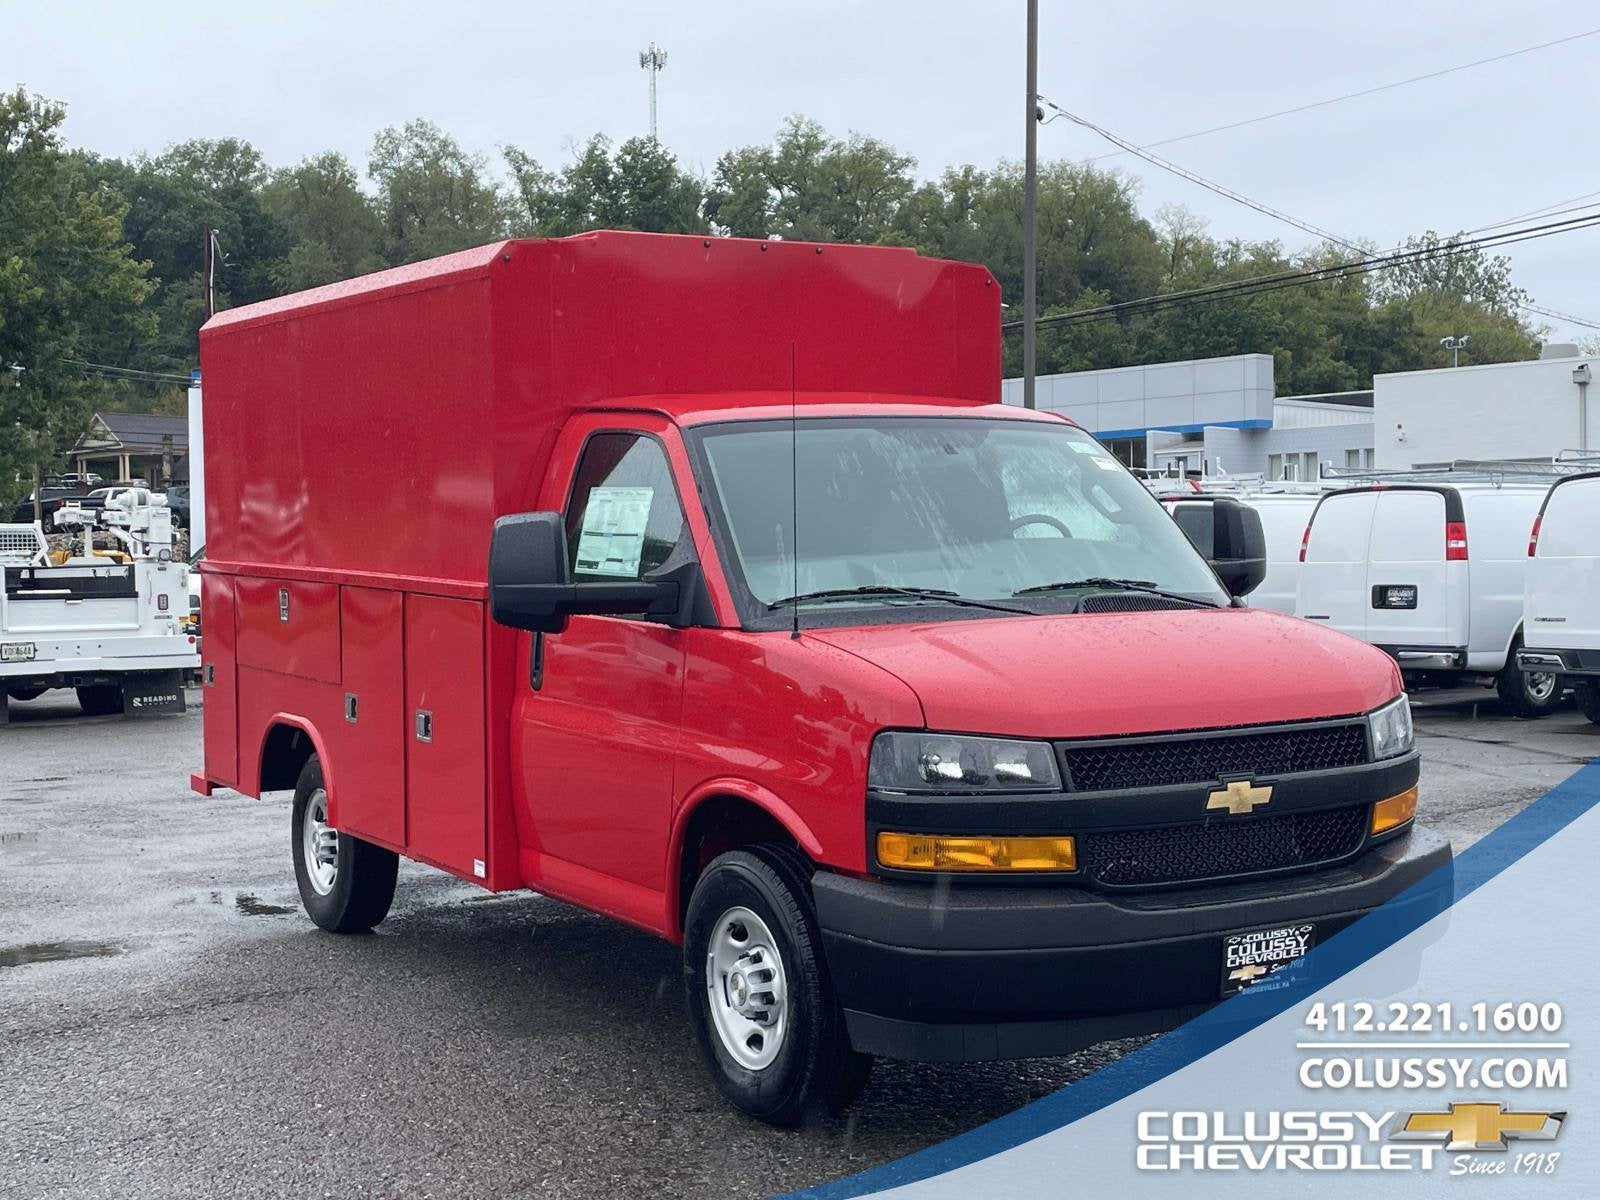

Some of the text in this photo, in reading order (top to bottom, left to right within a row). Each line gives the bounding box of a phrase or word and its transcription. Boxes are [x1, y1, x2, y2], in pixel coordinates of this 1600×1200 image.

[1227, 934, 1310, 958] COLUSSY
[1246, 928, 1296, 943] COLUSSY
[1226, 946, 1307, 967] CHEVROLET
